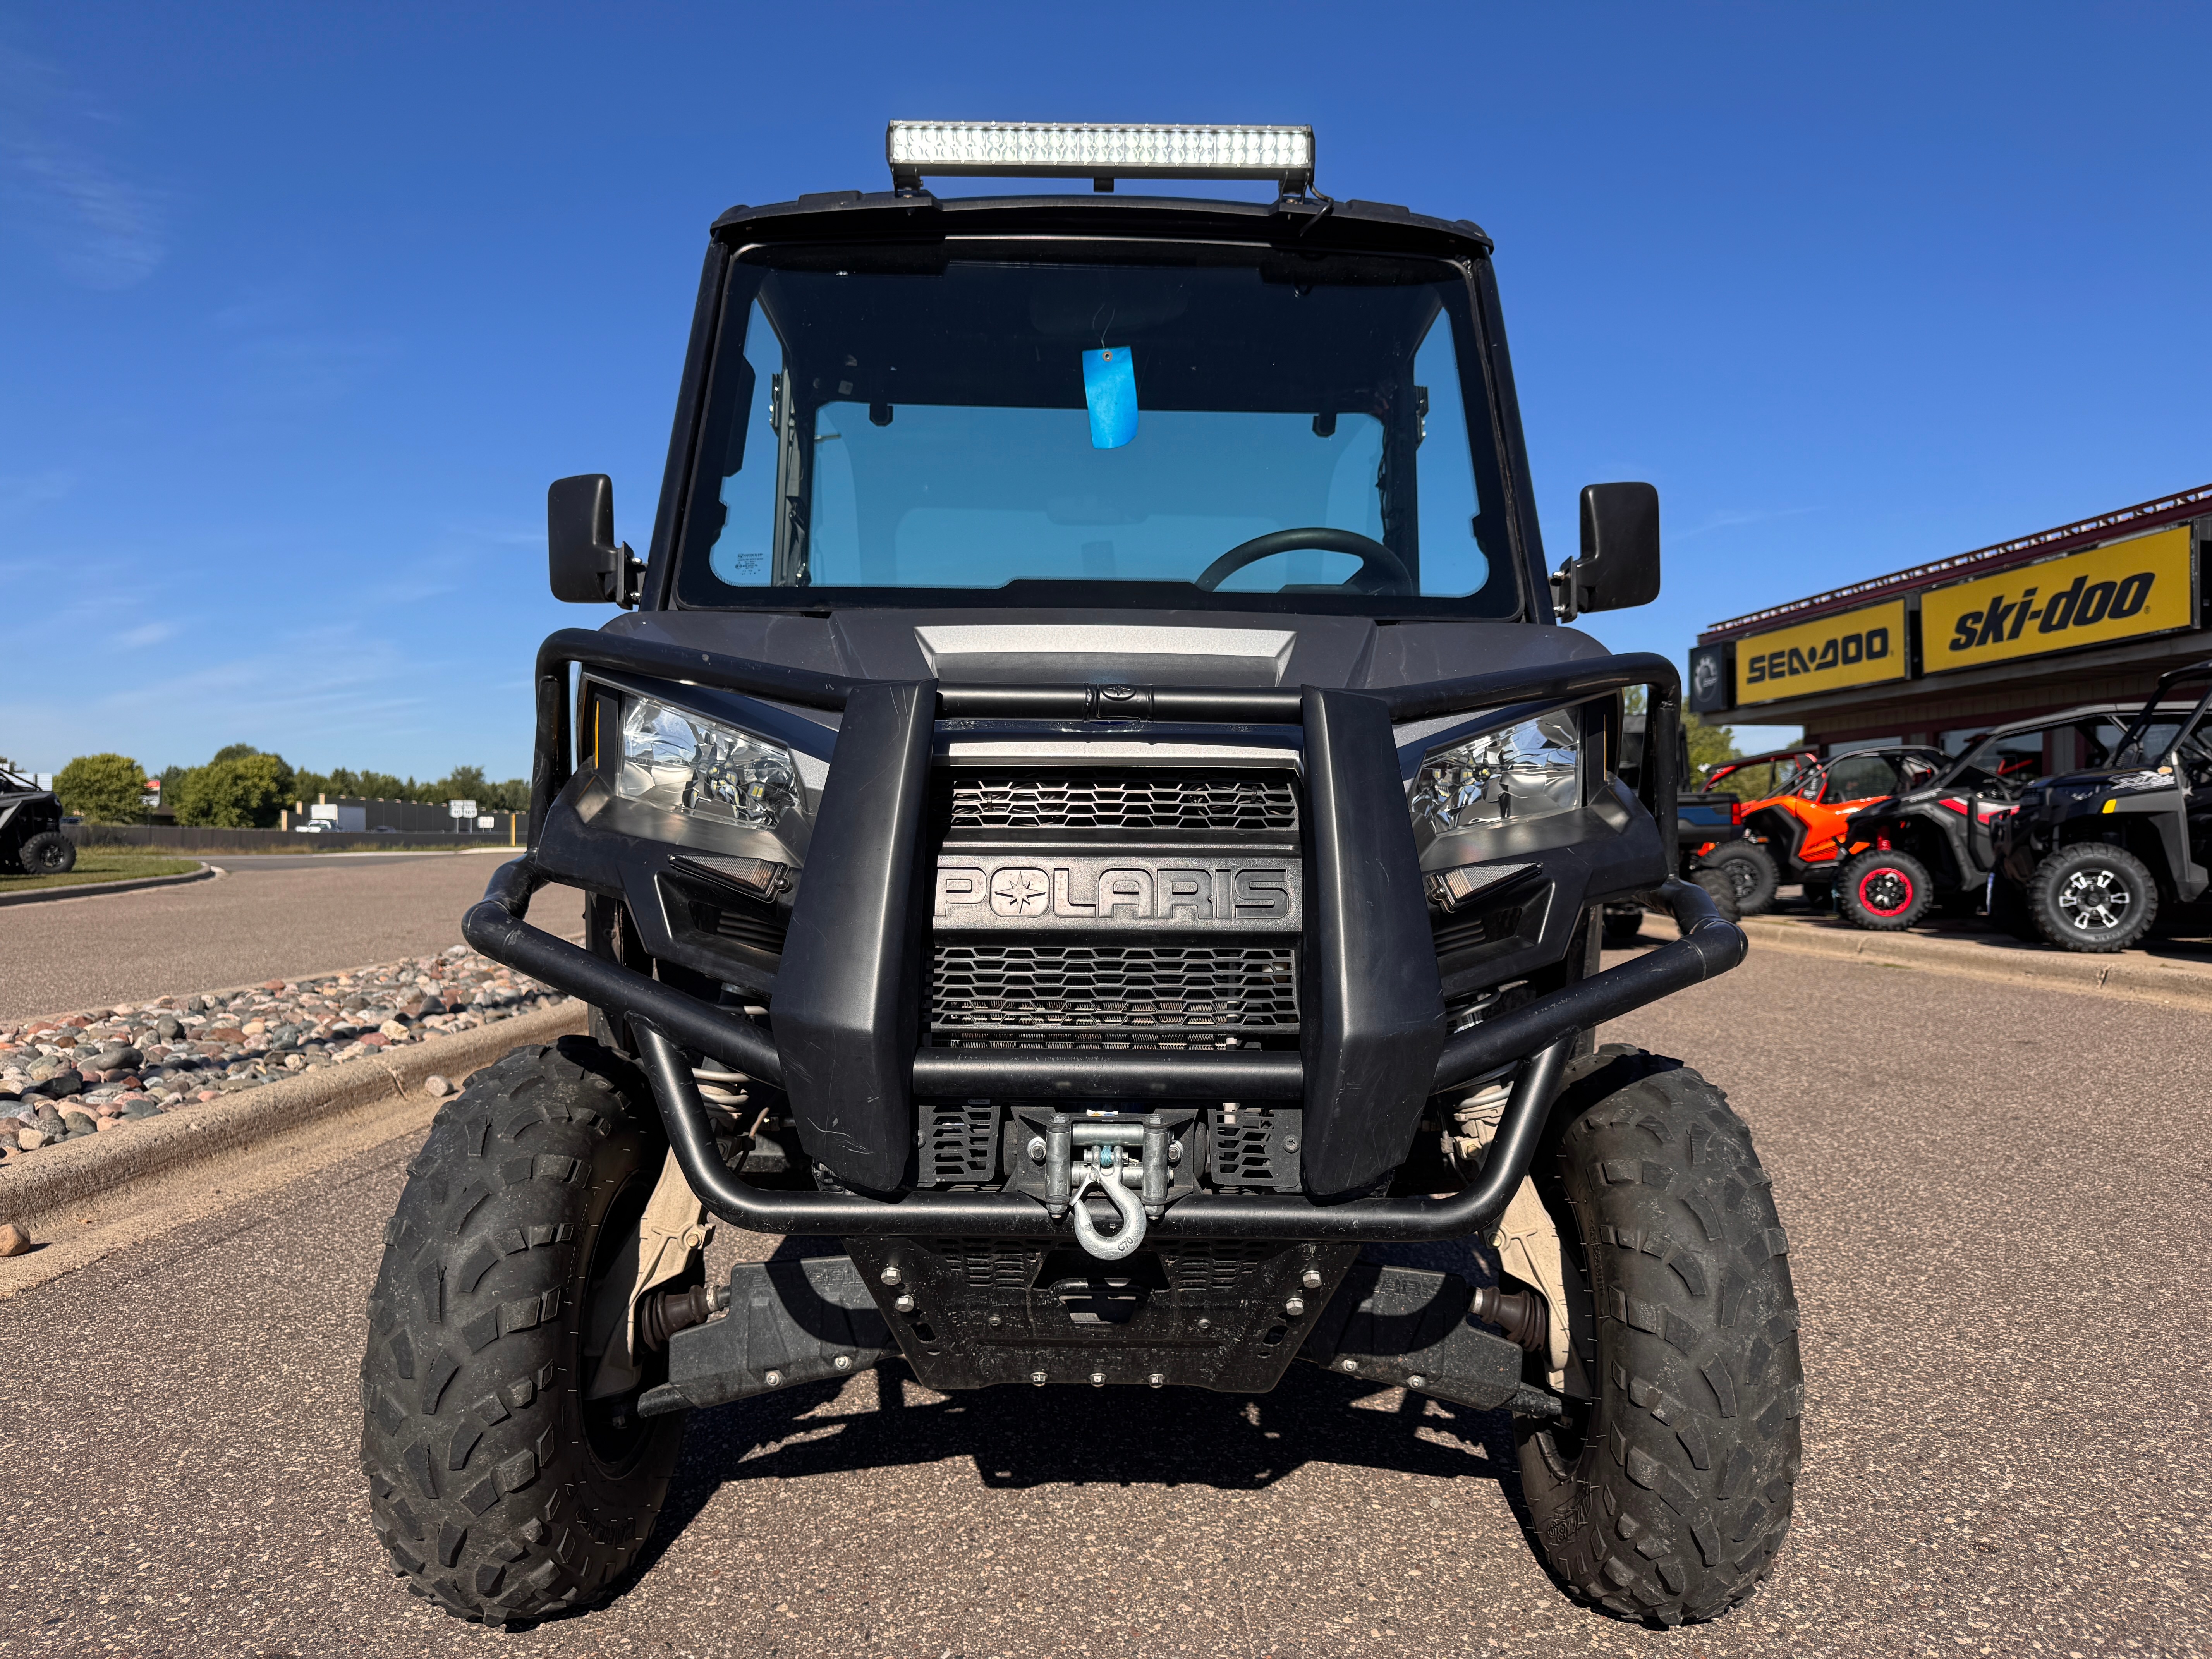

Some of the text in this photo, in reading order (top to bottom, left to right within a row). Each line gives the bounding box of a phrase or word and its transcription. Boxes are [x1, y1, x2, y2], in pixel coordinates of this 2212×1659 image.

[1949, 572, 2155, 651] ski-doo
[934, 866, 1290, 919] POLARIS
[1118, 1237, 1133, 1251] G70
